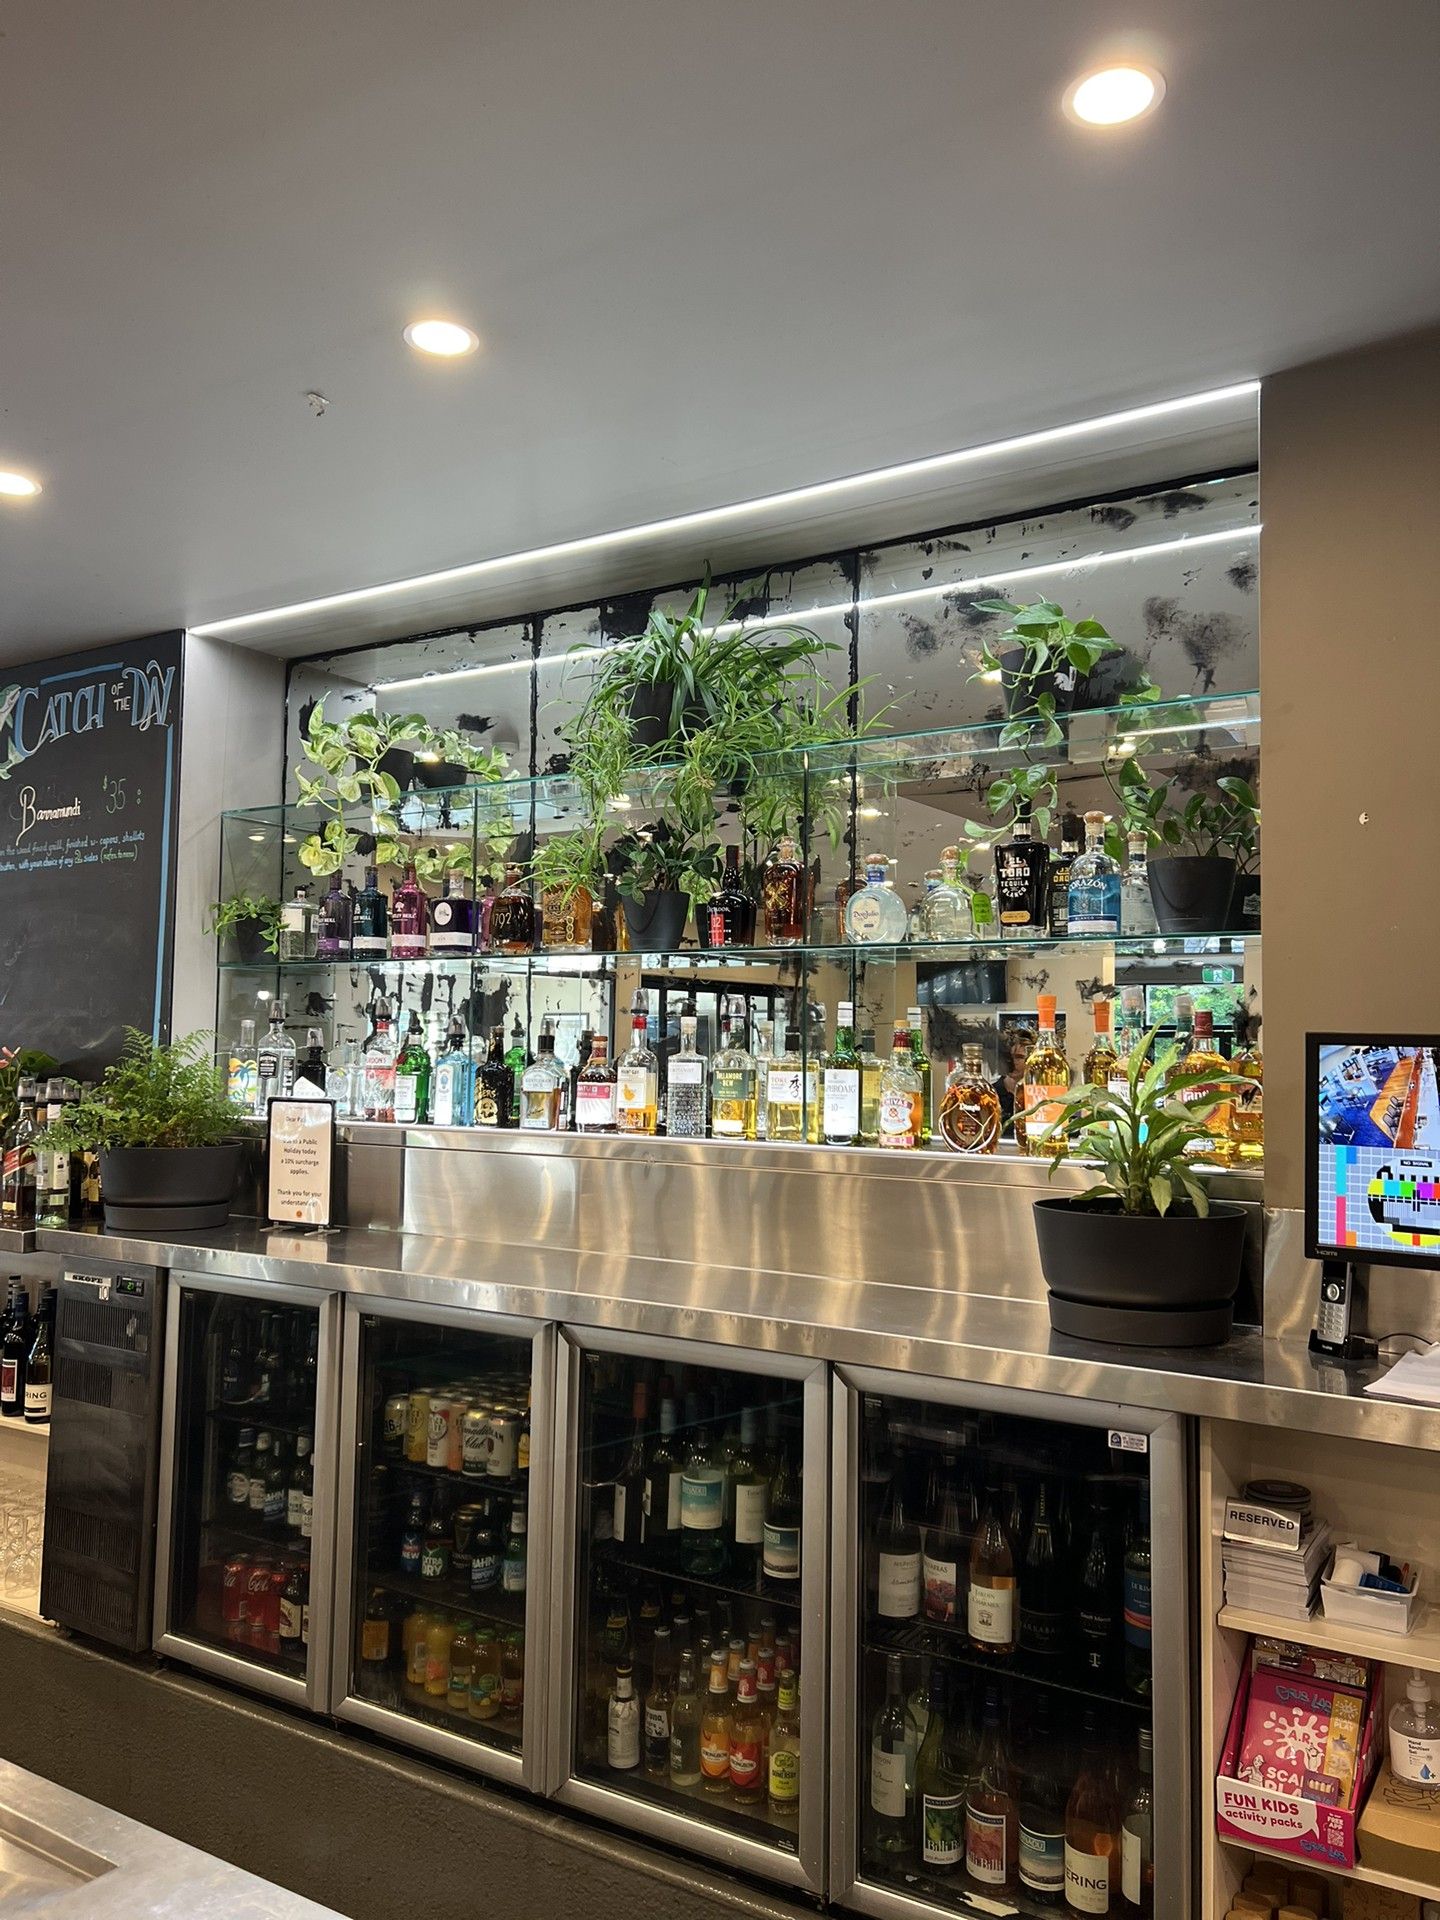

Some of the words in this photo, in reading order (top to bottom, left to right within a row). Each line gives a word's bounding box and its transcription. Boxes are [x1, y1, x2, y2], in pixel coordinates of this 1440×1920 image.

[111, 682, 125, 696] OF
[113, 696, 131, 711] THE
[15, 682, 106, 758] CATCH
[999, 867, 1031, 878] TORO
[1002, 886, 1027, 898] BLANCO
[1069, 879, 1107, 892] CORAZÓN
[715, 1071, 743, 1080] TULLAMORE
[295, 1158, 320, 1167] surcharge
[1229, 1510, 1295, 1531] RESERVED
[1288, 1731, 1314, 1746] A.R.
[1224, 1792, 1259, 1809] FUN
[1261, 1799, 1300, 1816] KIDS
[1225, 1809, 1267, 1826] activity
[1271, 1817, 1303, 1830] packs
[1327, 1816, 1344, 1826] FREE
[1328, 1822, 1343, 1831] APP
